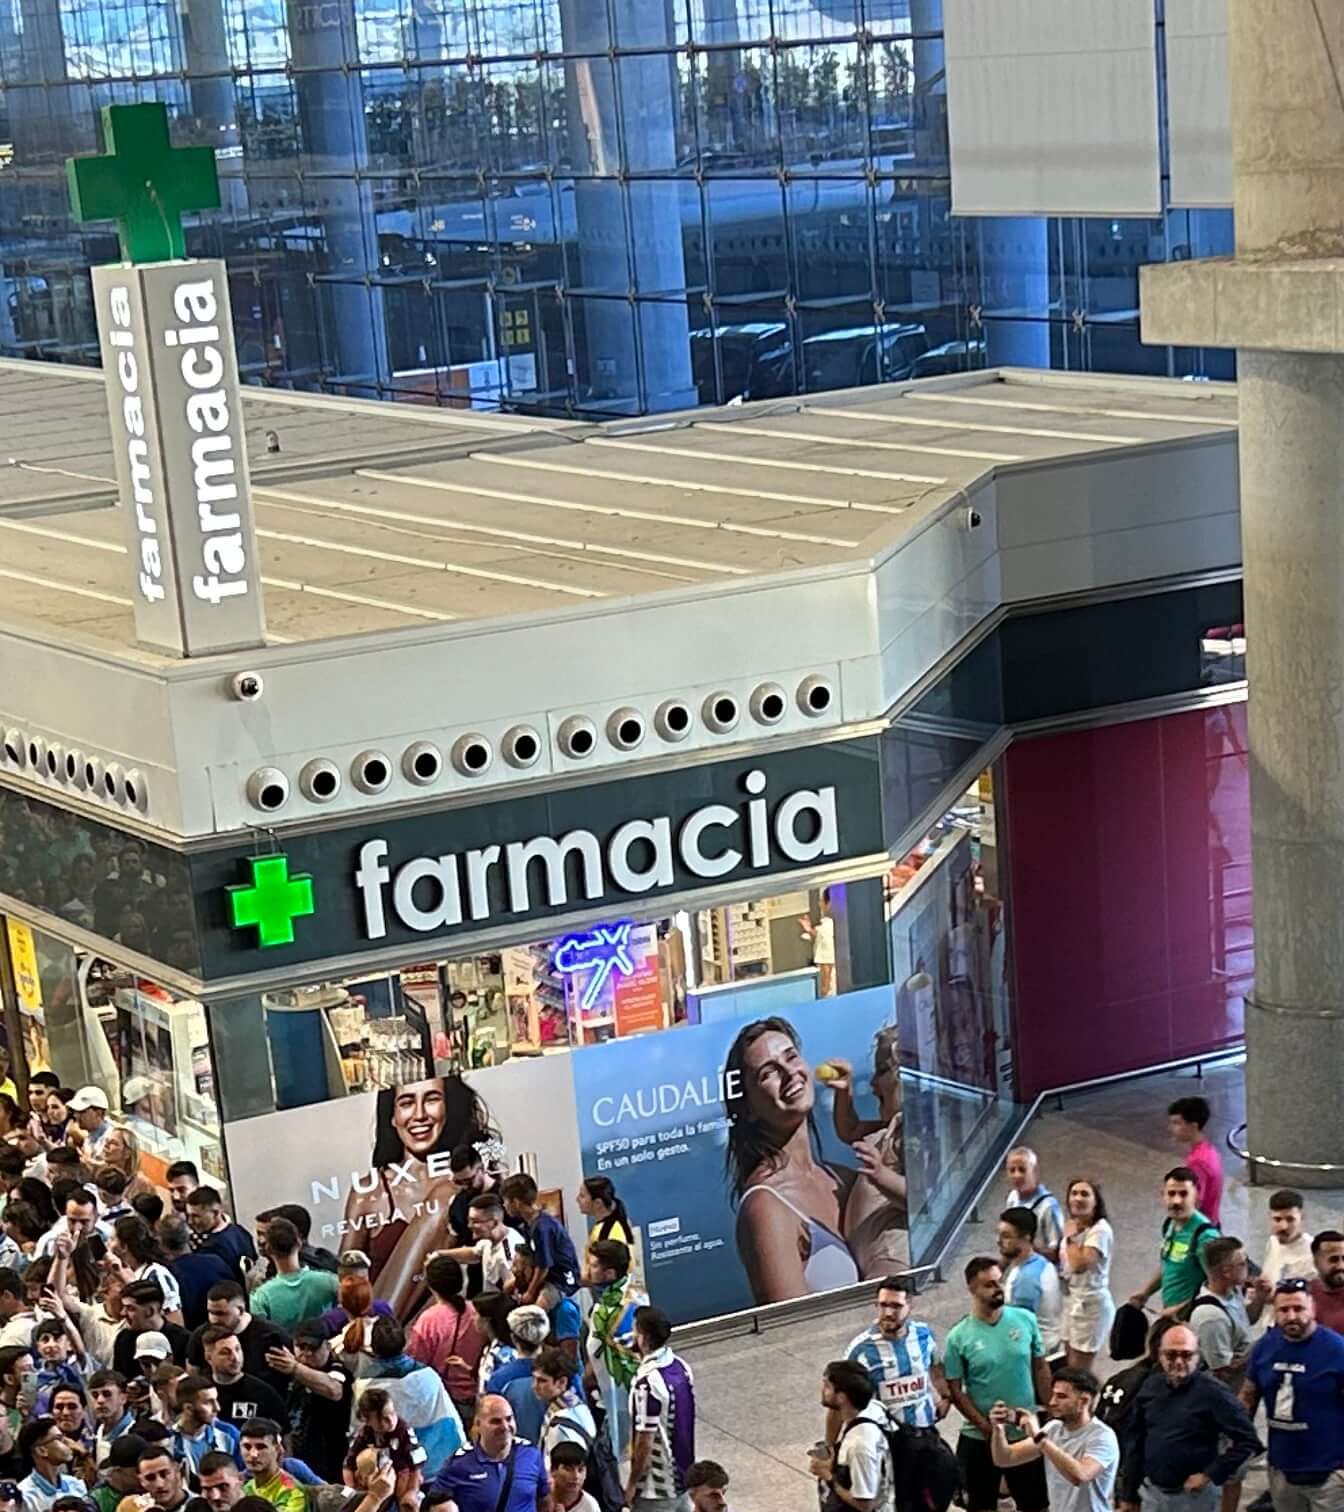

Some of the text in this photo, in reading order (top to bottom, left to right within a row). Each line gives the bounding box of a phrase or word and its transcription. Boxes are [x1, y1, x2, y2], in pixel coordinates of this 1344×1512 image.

[109, 286, 166, 603] farmacia
[164, 278, 248, 604] farmacia
[355, 770, 841, 940] farmacia
[596, 1138, 631, 1156] SPF50
[631, 1134, 657, 1149] para
[658, 1127, 684, 1142] toda
[685, 1124, 696, 1136] la
[597, 1144, 690, 1171] En un solo gesto.
[311, 1150, 453, 1205] NUXE
[320, 1199, 440, 1239] REVELA TU
[885, 1375, 926, 1397] Tivoli
